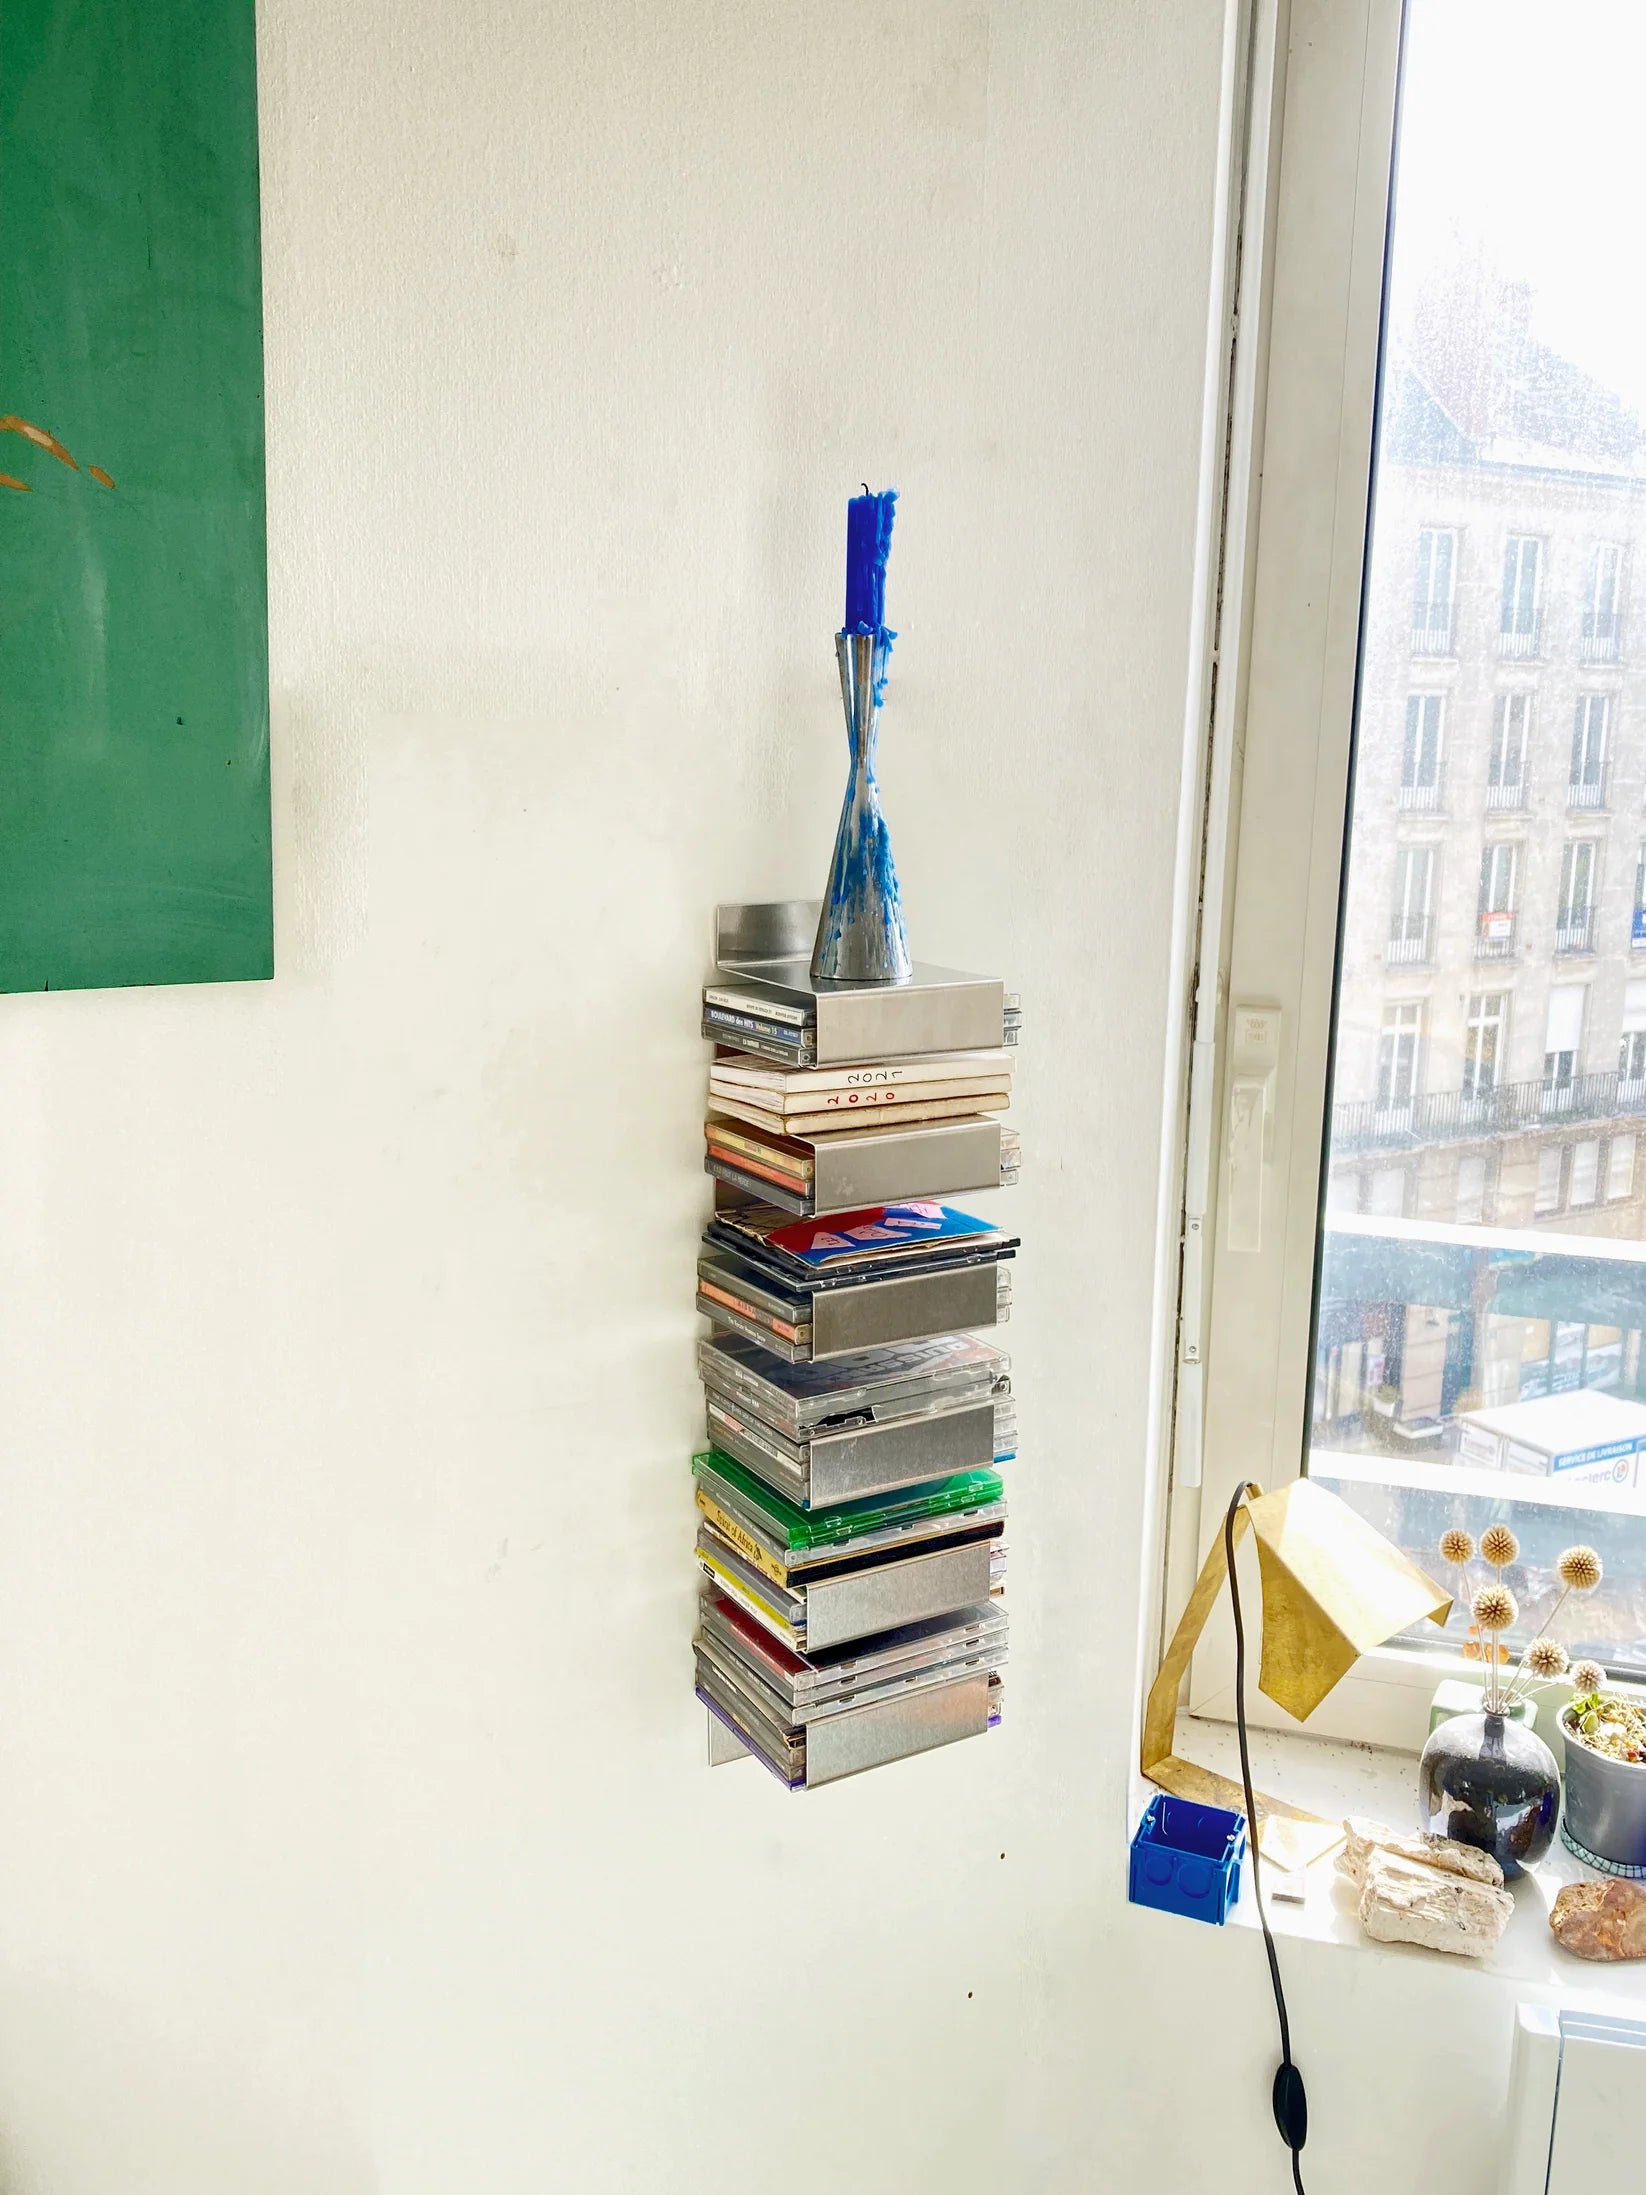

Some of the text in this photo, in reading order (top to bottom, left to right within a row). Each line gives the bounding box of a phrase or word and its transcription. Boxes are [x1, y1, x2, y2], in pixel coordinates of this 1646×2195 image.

[744, 1019, 754, 1029] HITS
[827, 1092, 895, 1105] 2020
[1586, 1449, 1597, 1461] DE
[732, 1526, 738, 1537] of
[737, 1531, 753, 1553] Africa
